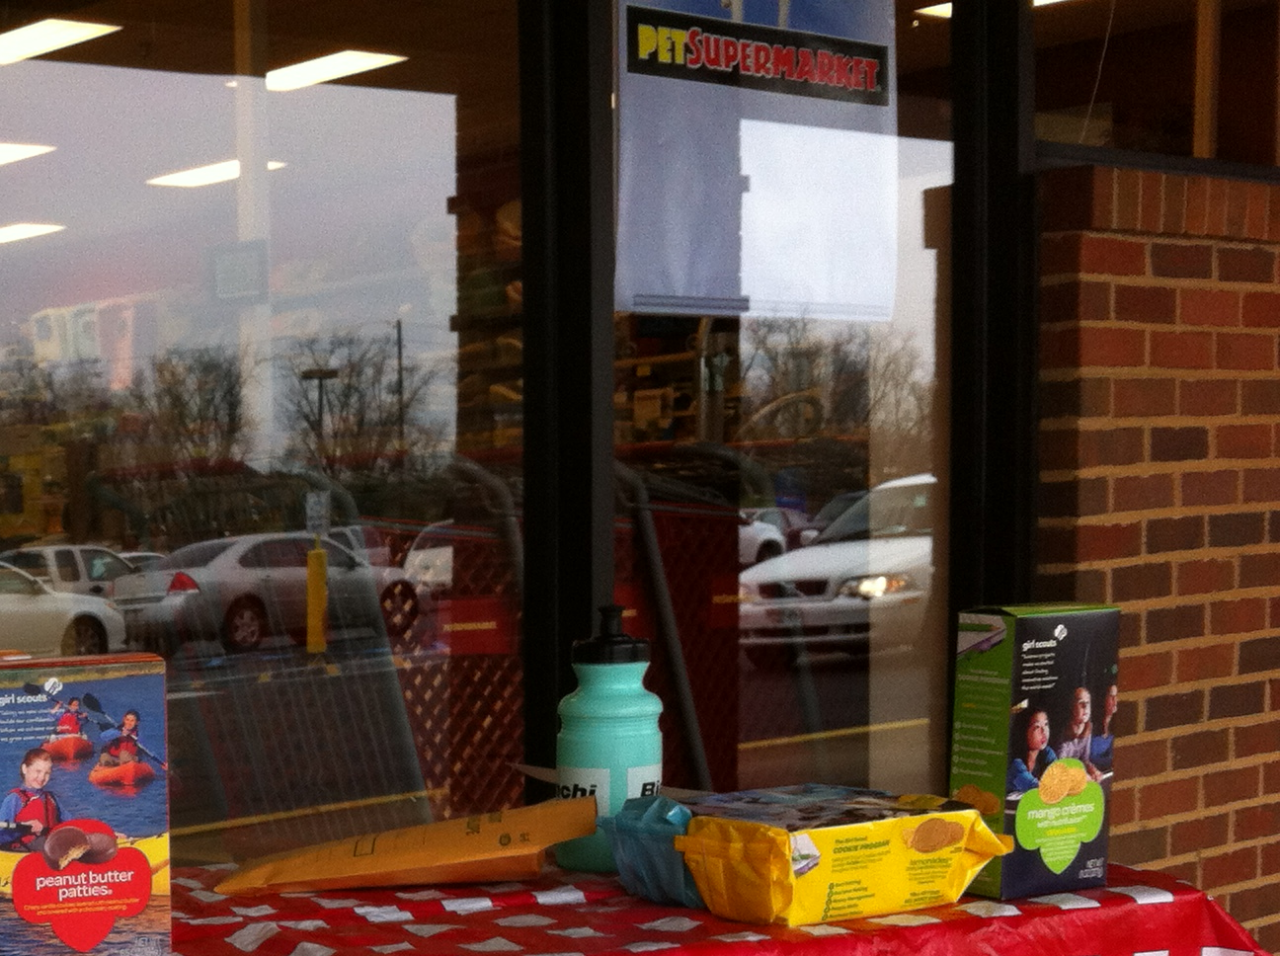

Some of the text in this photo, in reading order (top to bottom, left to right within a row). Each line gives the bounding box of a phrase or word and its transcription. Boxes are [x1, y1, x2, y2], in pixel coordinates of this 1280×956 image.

[16, 694, 48, 703] scouts
[36, 870, 134, 891] peanut butter
